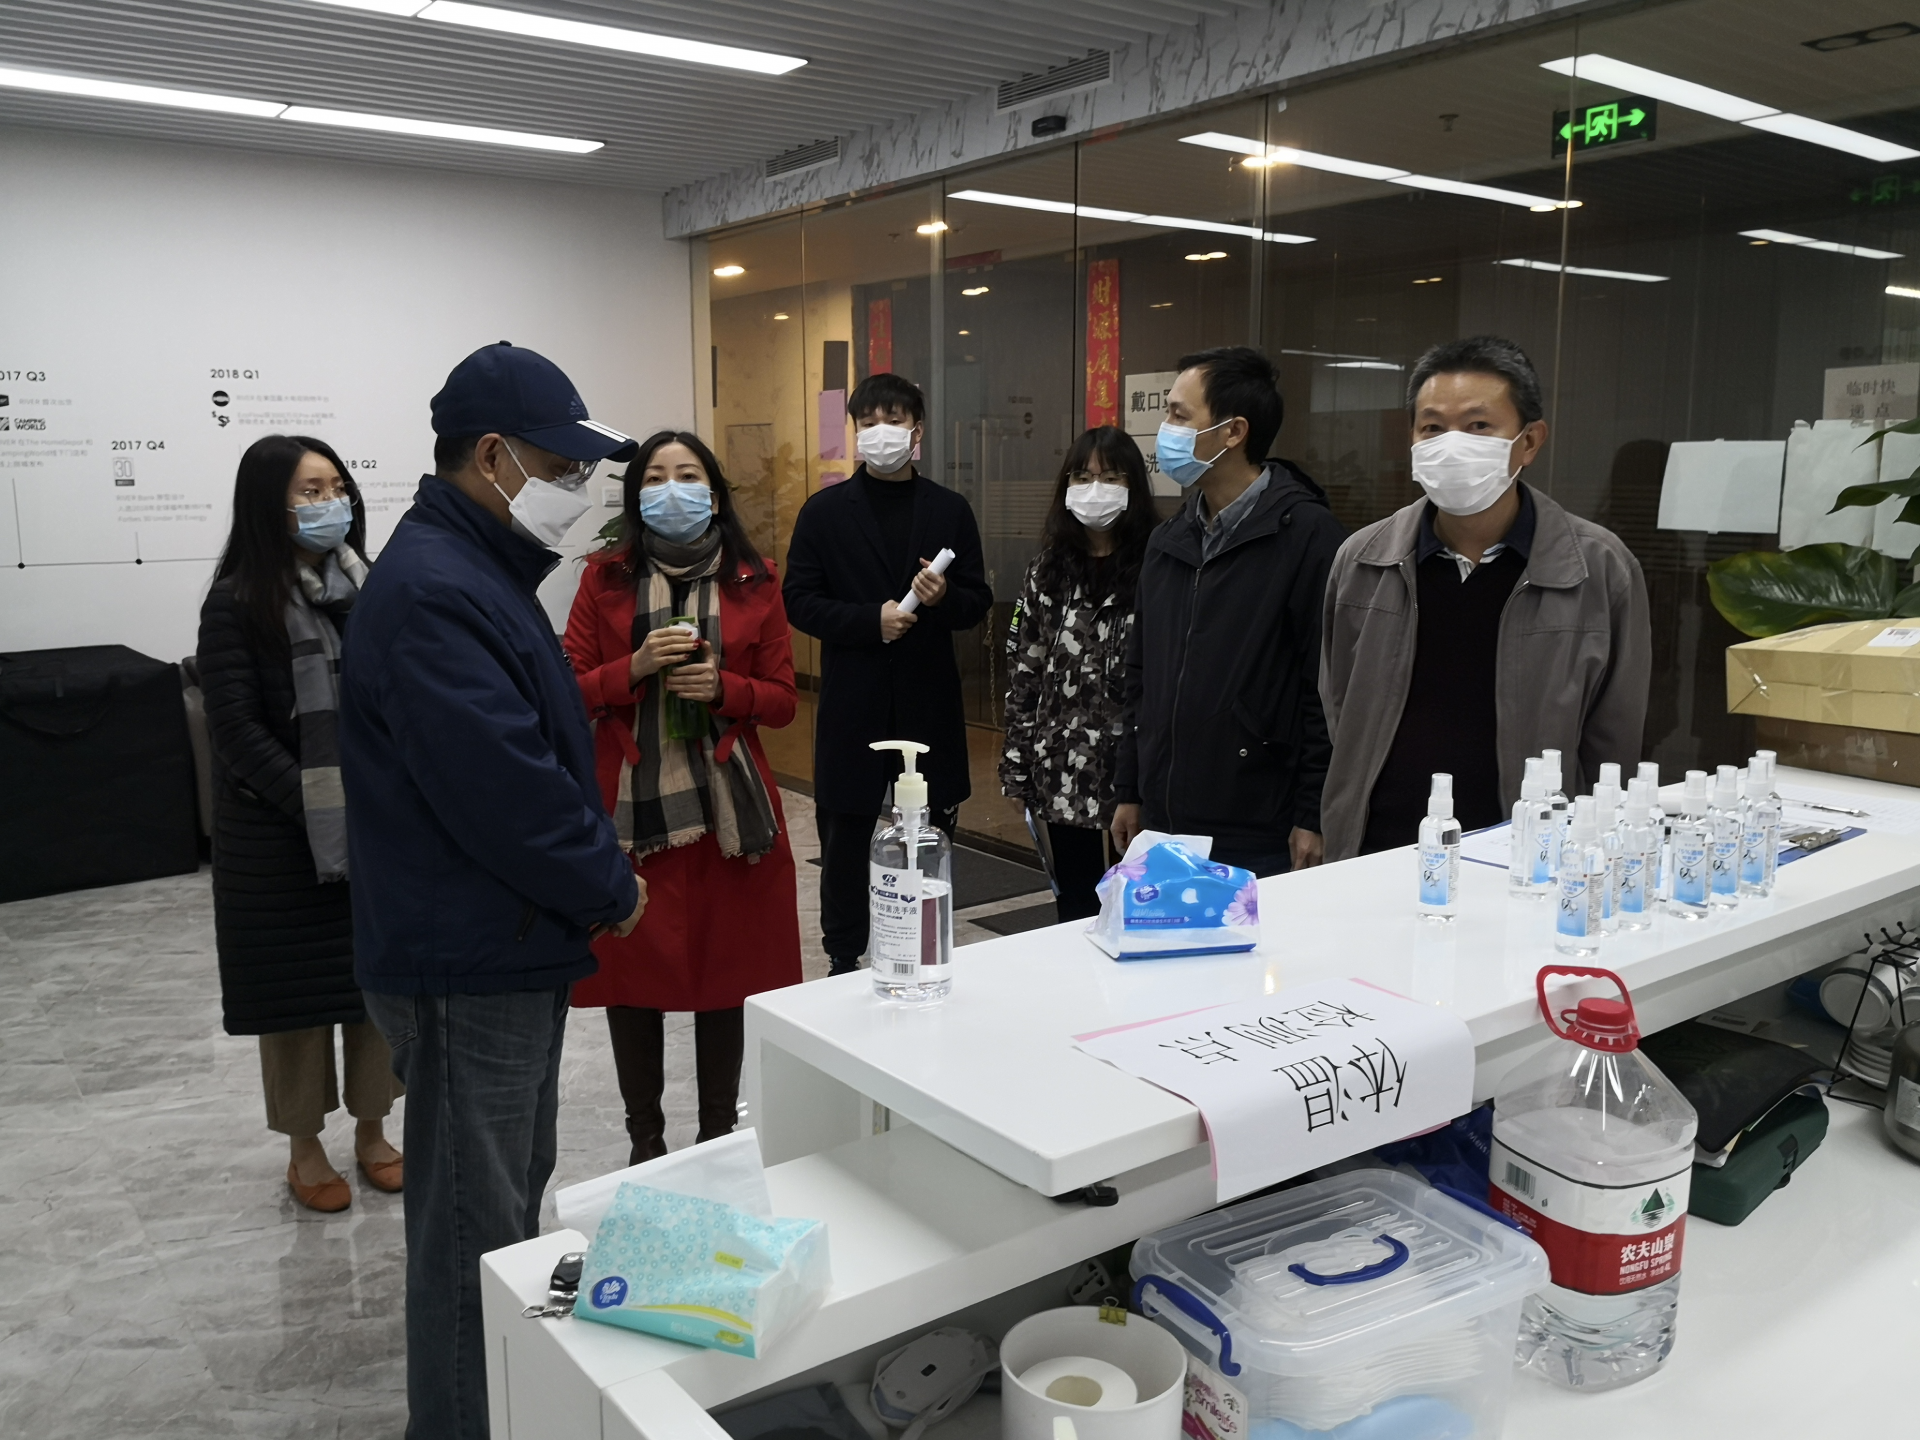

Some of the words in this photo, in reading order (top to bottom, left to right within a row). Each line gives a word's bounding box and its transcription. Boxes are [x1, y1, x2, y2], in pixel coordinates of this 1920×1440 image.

[26, 371, 47, 382] Q3
[210, 368, 240, 379] 2018
[243, 368, 260, 380] Q1
[1846, 378, 1896, 396] 临时快
[16, 422, 47, 431] WORLD
[111, 440, 142, 451] 2017
[146, 440, 166, 451] Q4
[361, 459, 378, 470] Q2
[1158, 1000, 1376, 1065] 检测点
[1272, 1037, 1407, 1133] 体温
[1620, 1232, 1675, 1264] 农夫山泉
[1620, 1260, 1649, 1275] NONGFU
[1650, 1251, 1673, 1268] SPRING
